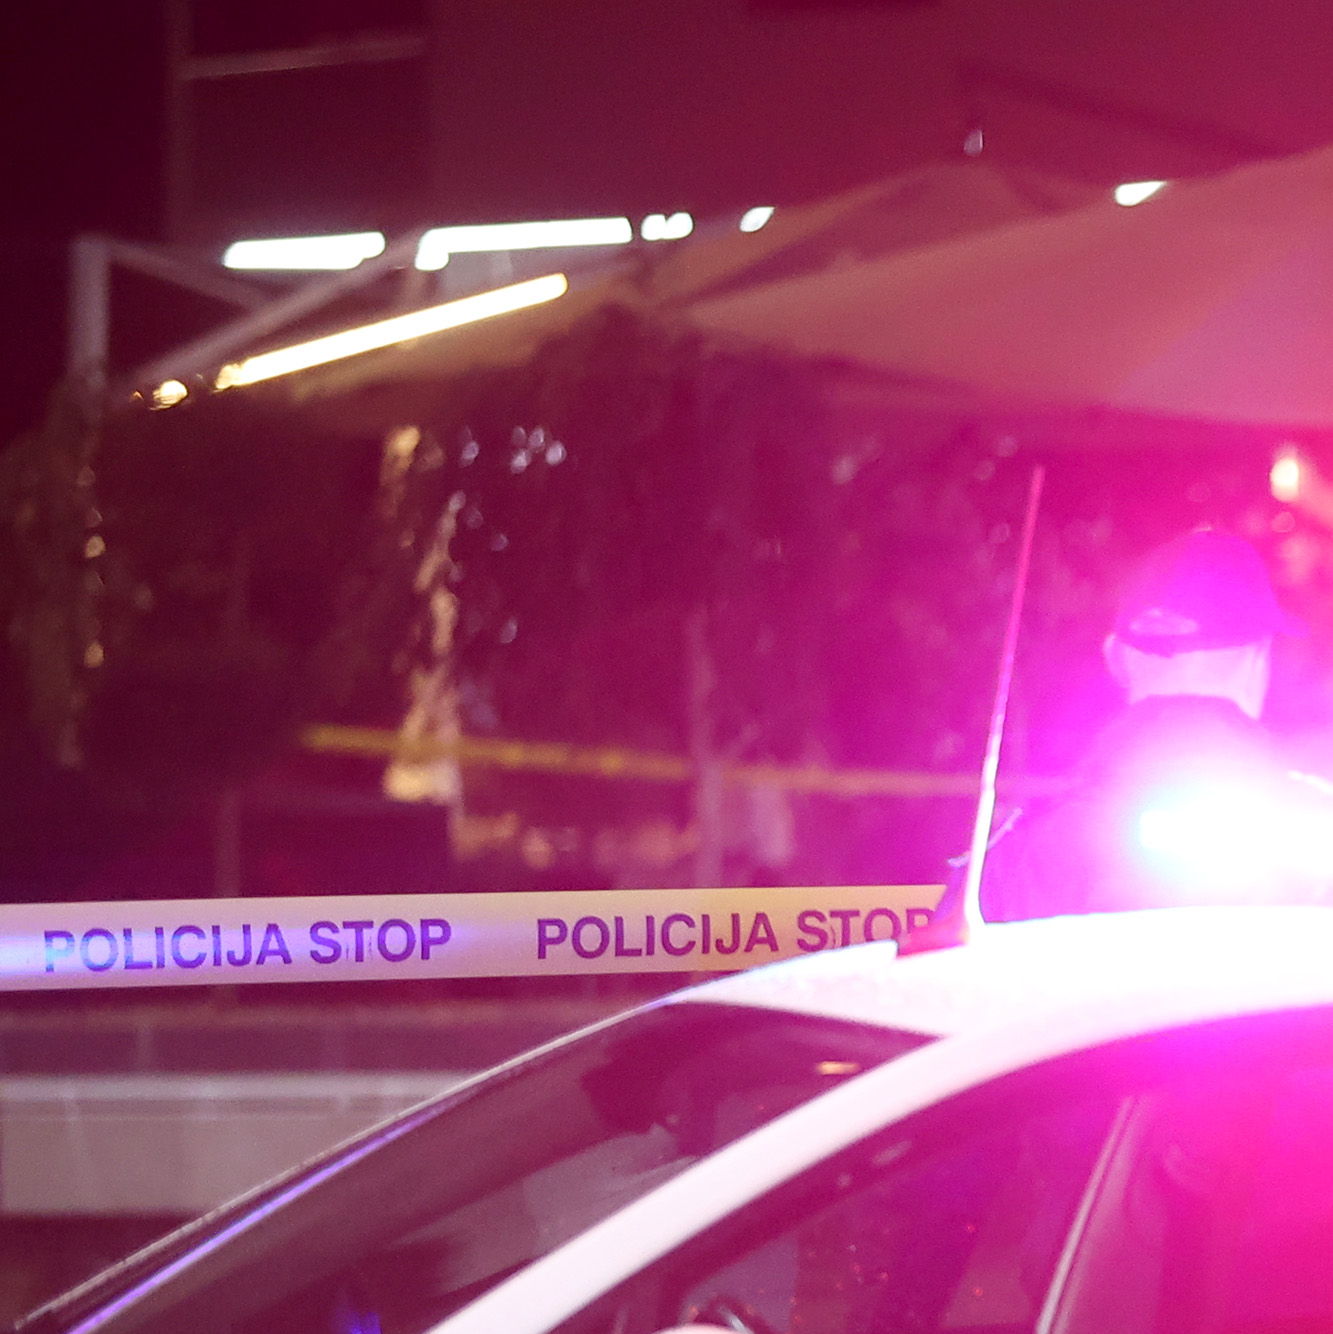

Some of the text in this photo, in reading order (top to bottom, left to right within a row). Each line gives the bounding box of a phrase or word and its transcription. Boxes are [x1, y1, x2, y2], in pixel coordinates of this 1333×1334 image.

[43, 919, 452, 973] POLICIJA STOP
[537, 912, 778, 960] POLICIJA
